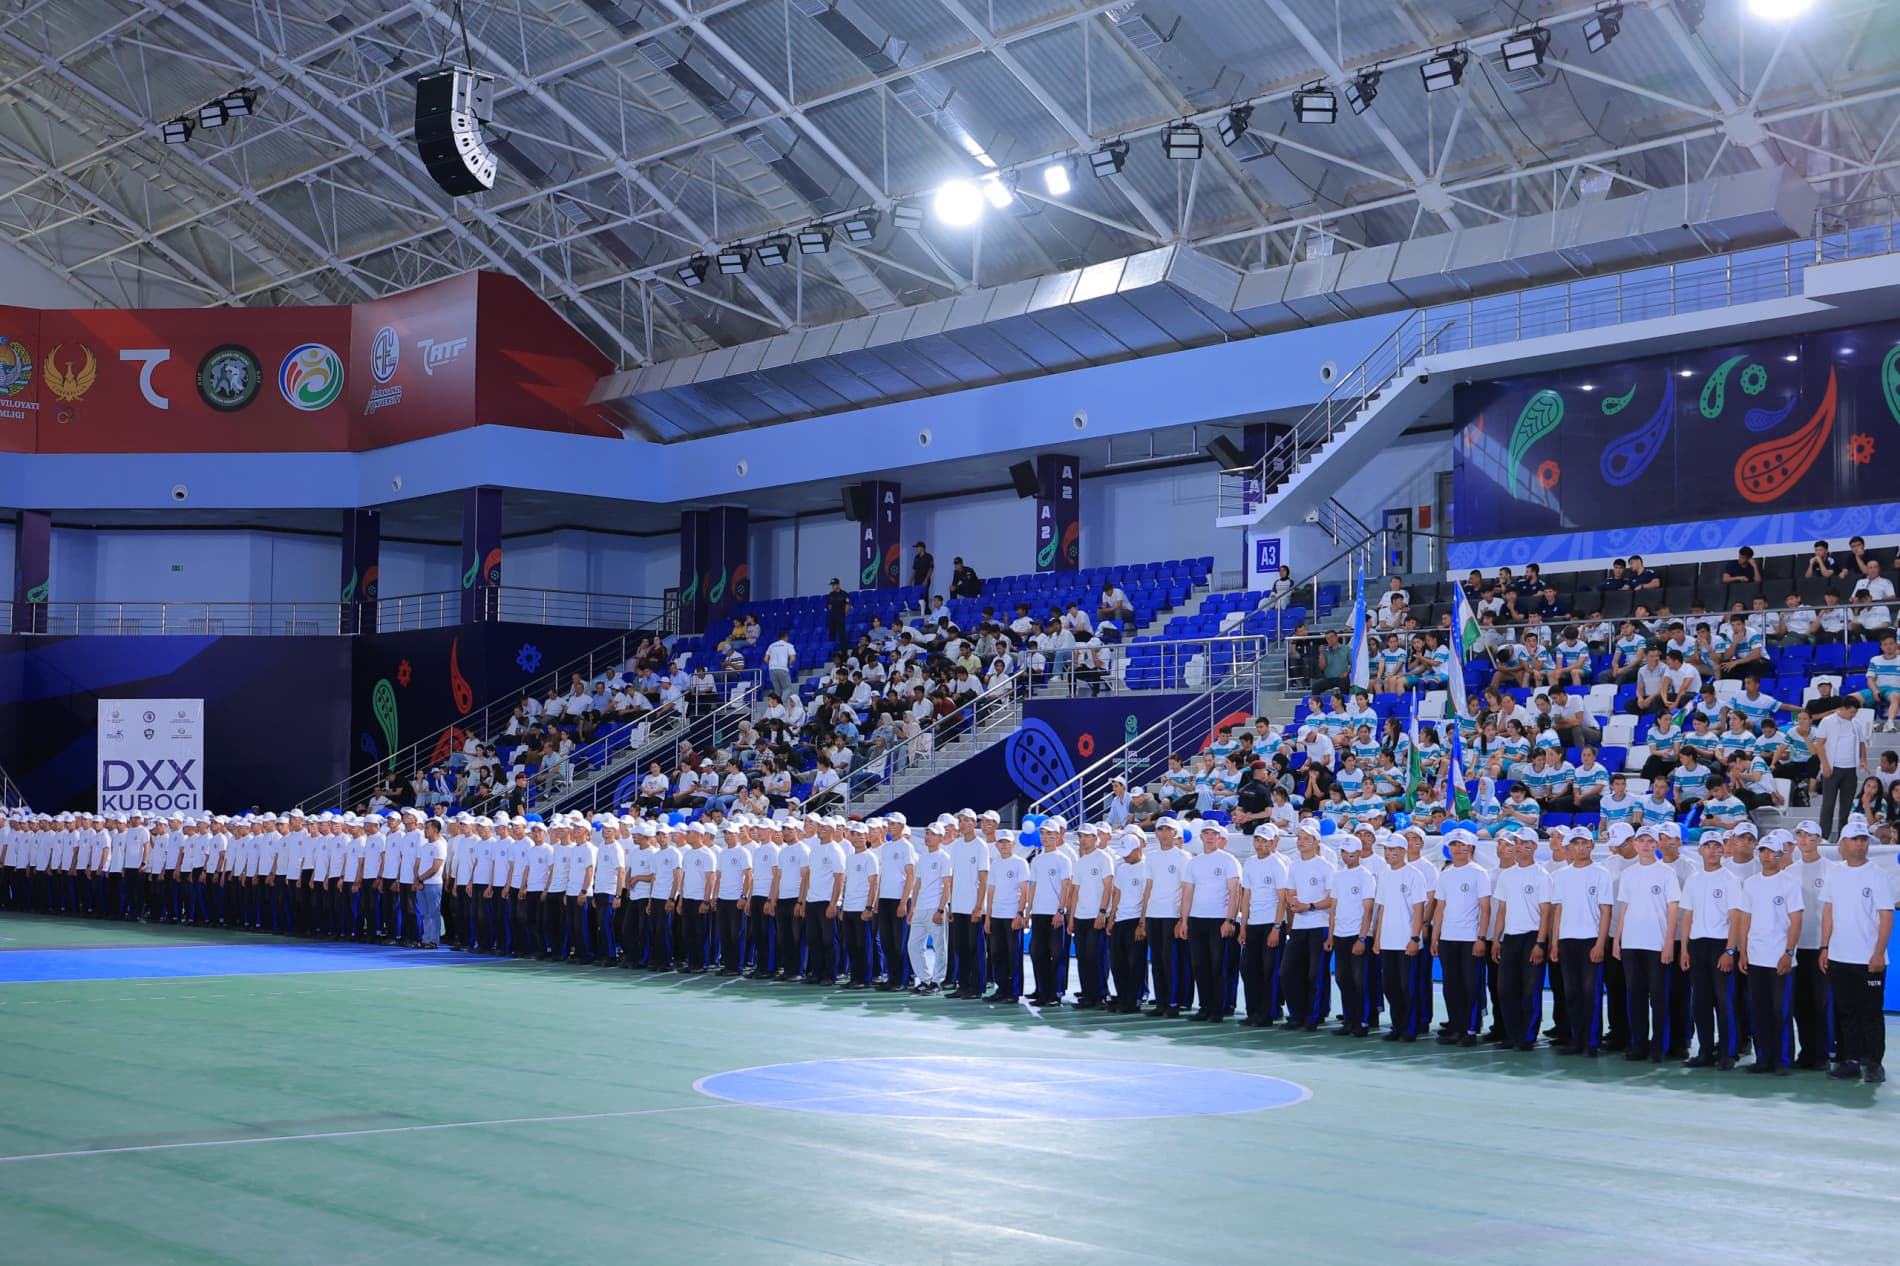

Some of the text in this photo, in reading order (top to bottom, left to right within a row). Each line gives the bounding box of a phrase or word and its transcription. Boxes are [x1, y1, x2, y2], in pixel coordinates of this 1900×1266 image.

[0, 399, 40, 410] VILOYATI
[1261, 546, 1276, 566] A3
[102, 759, 196, 791] DXX
[102, 793, 197, 811] KUBOGI
